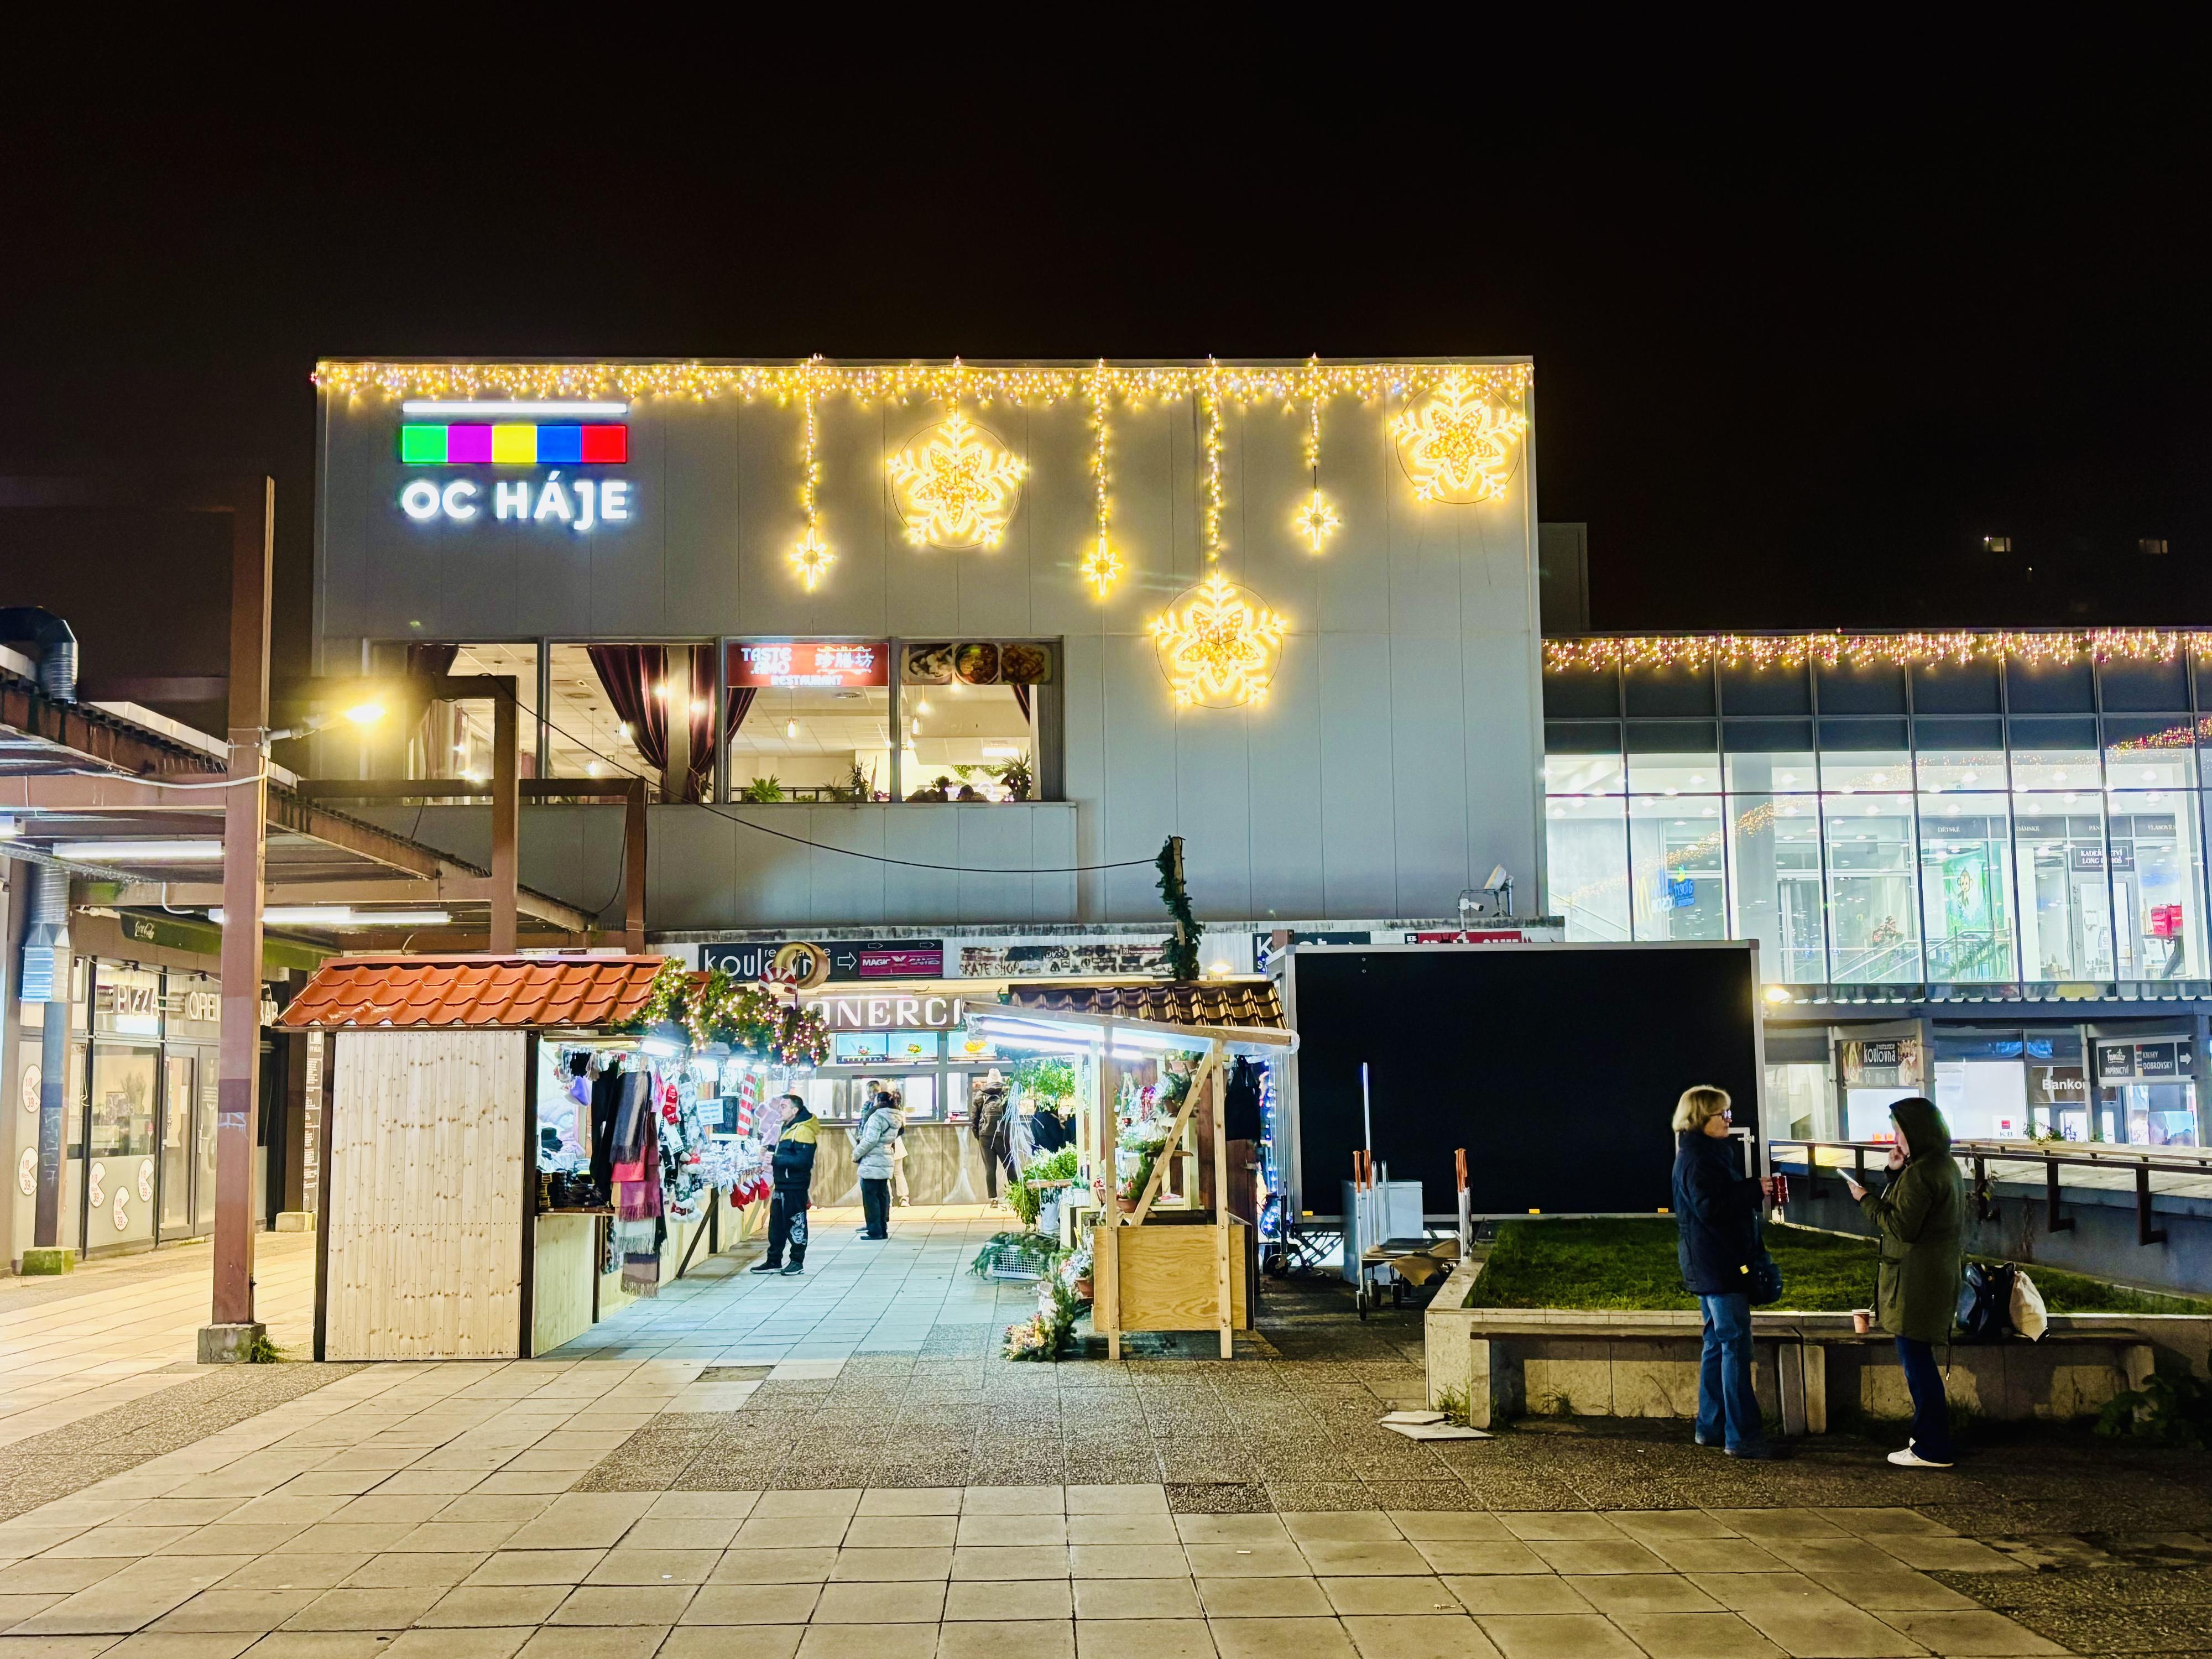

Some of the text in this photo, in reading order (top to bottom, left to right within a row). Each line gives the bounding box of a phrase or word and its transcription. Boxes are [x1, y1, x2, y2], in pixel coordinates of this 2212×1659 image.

[402, 470, 627, 530] OC HÁJE
[741, 647, 792, 661] TASTE
[959, 963, 991, 976] SKATE
[995, 961, 1019, 975] SHOP
[117, 984, 160, 1017] PIZZA
[1864, 1044, 1896, 1063] koulovna
[2042, 1078, 2085, 1090] Banko
